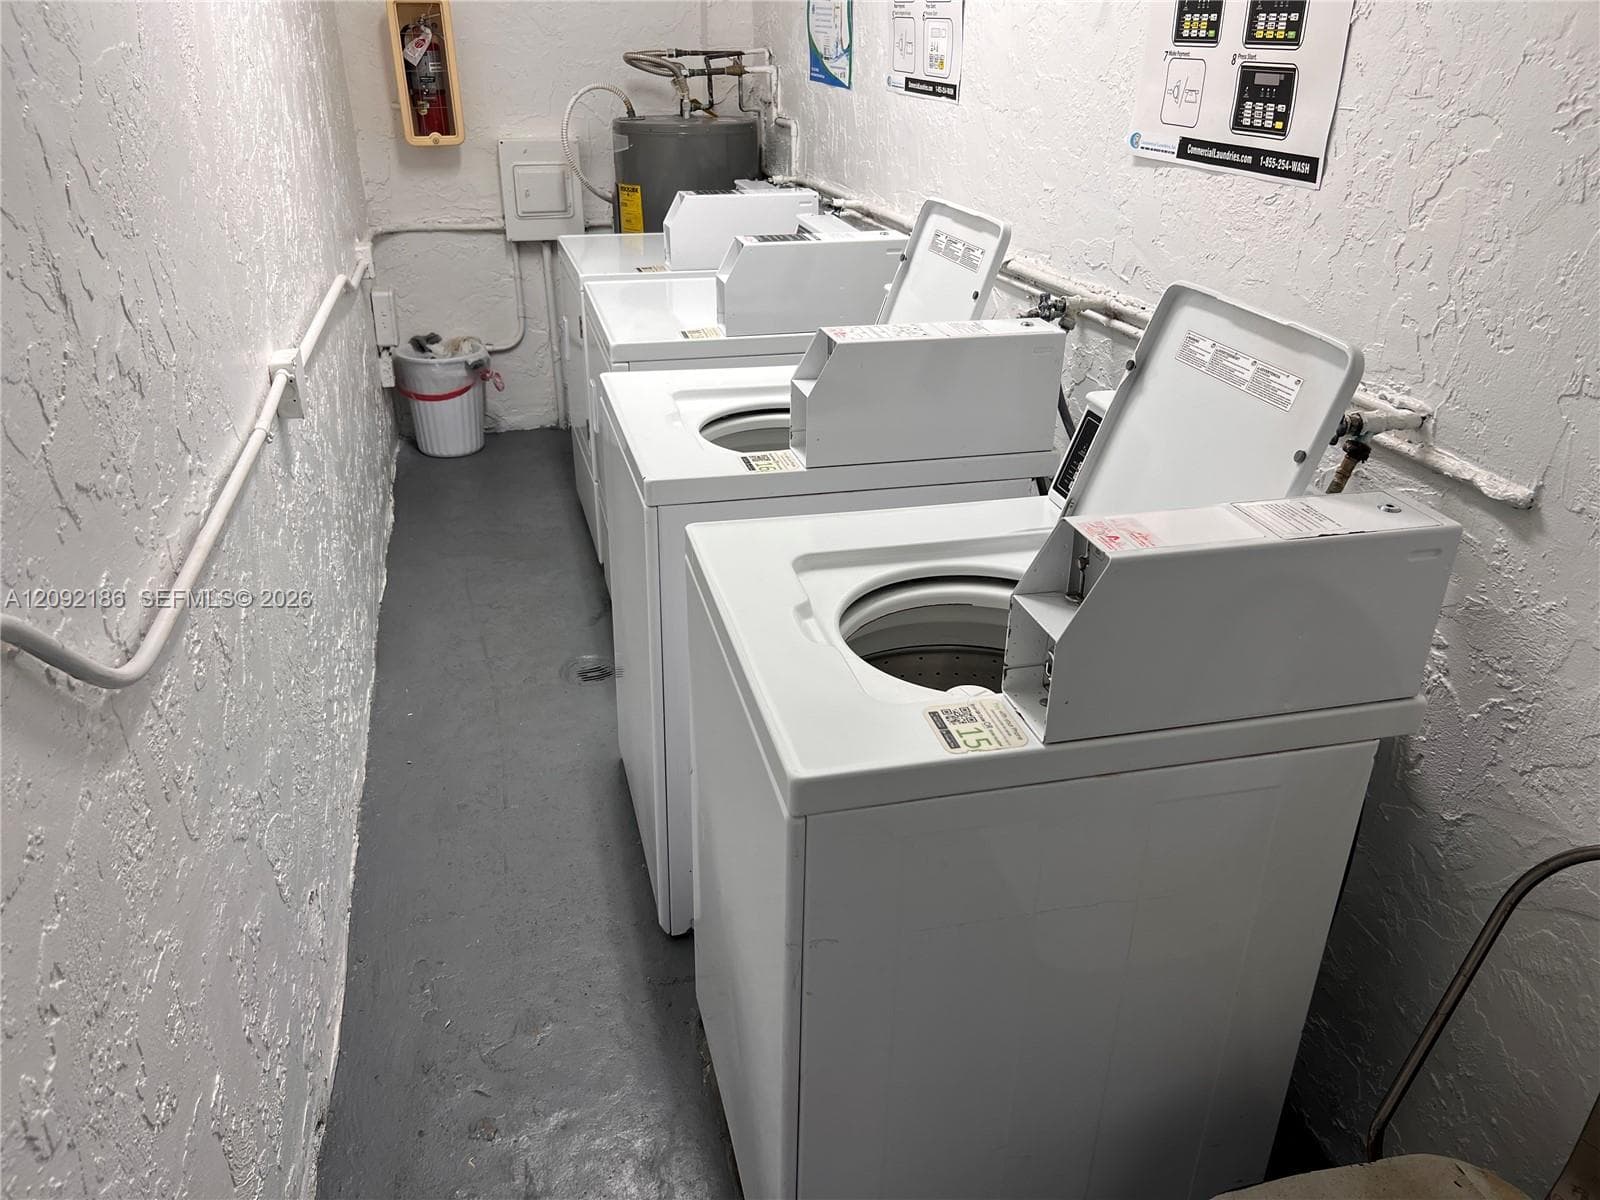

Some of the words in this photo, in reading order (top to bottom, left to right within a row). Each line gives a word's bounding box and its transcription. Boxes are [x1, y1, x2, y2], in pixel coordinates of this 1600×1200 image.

[1163, 51, 1168, 61] 7
[1231, 53, 1237, 65] 8
[1187, 144, 1253, 164] CommercialLaundries.com
[1259, 156, 1311, 175] 1-855-254-WASH
[955, 727, 993, 749] 15
